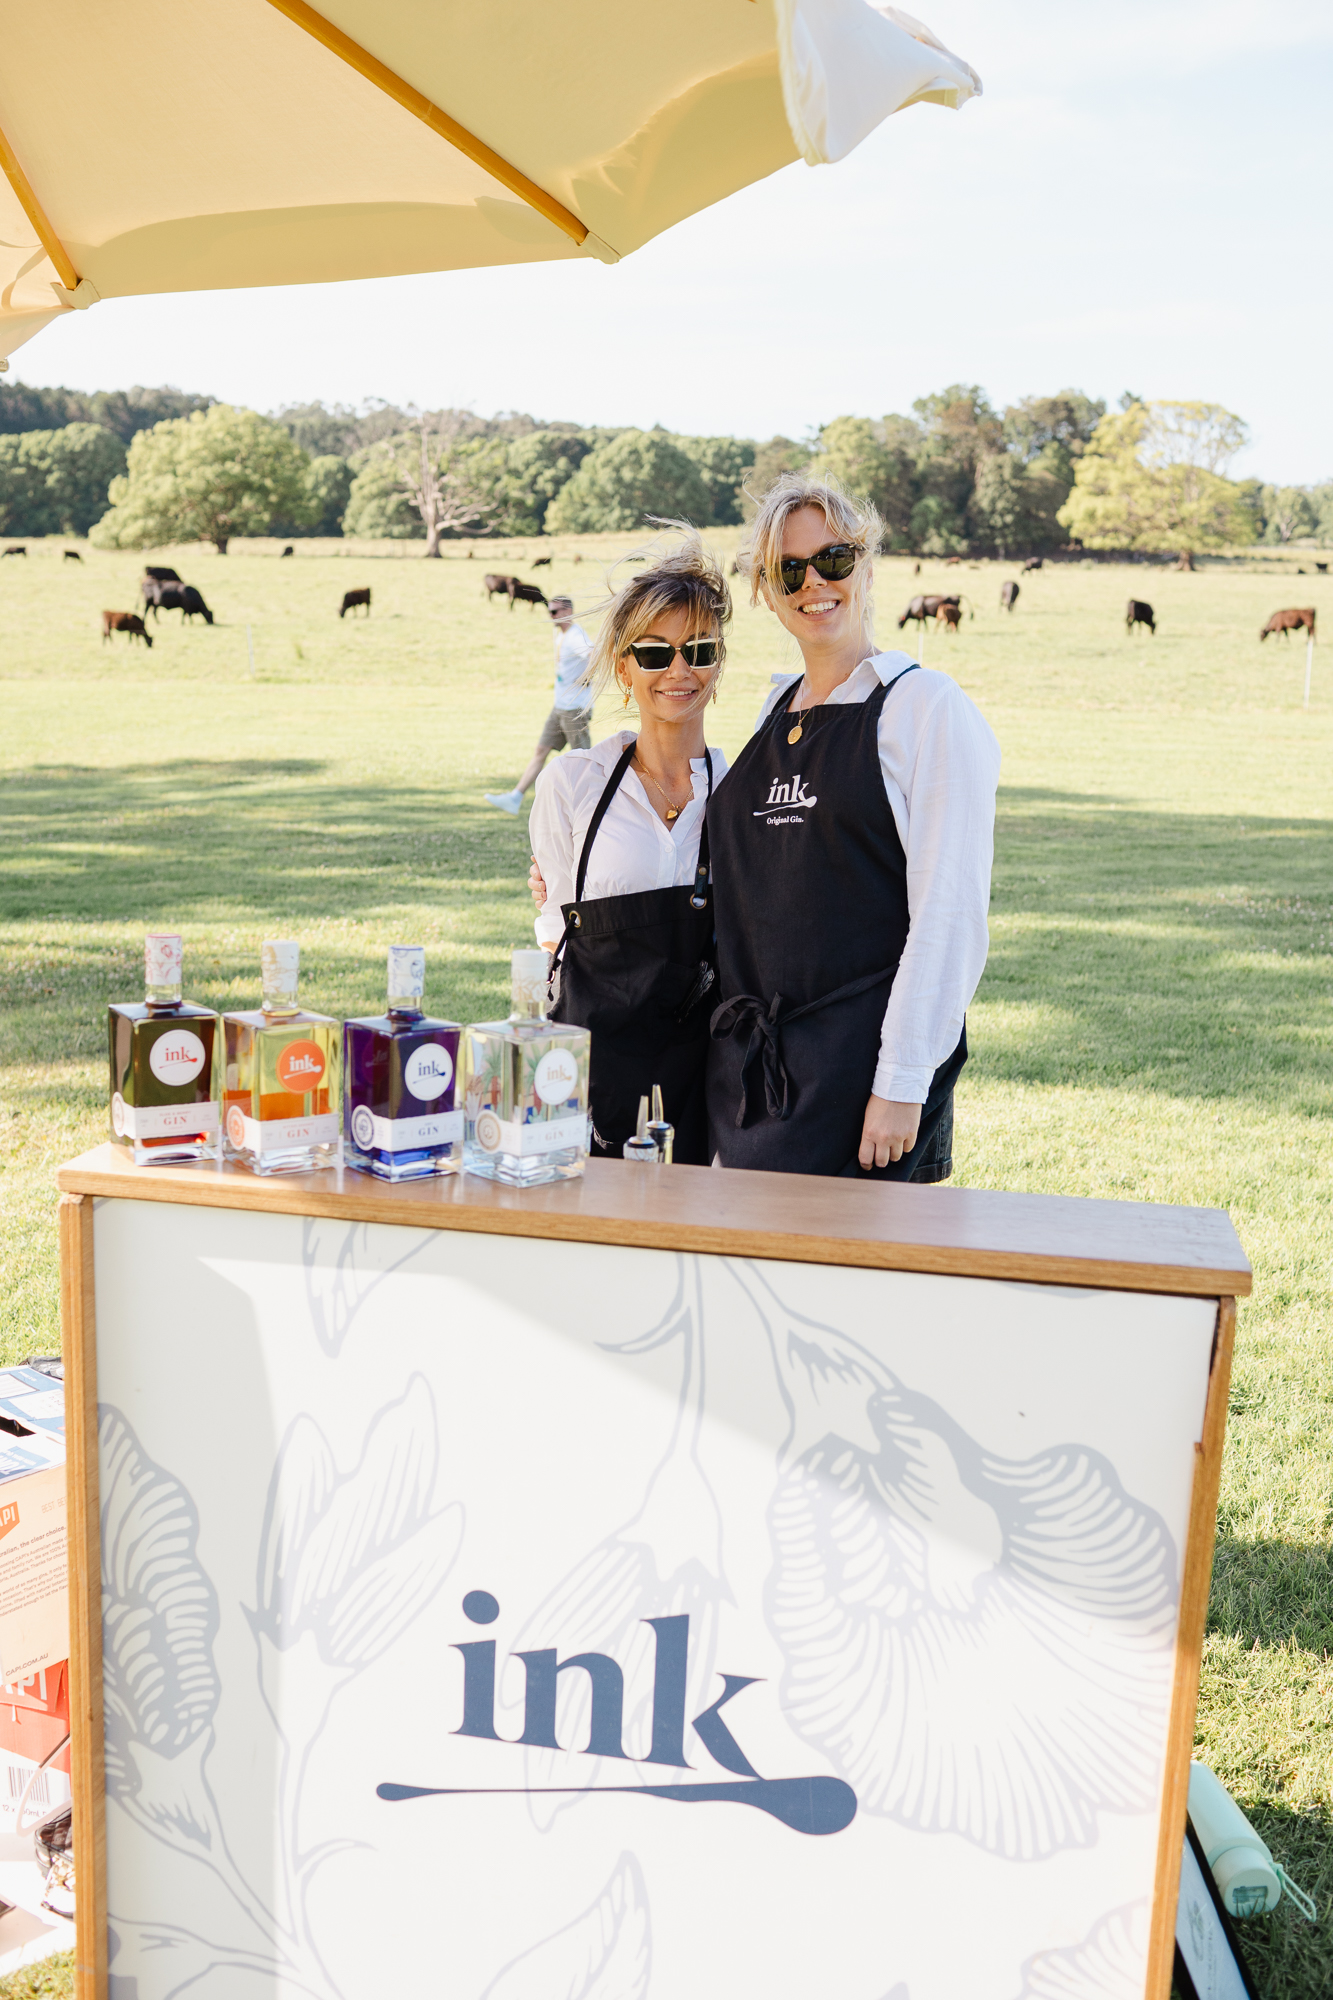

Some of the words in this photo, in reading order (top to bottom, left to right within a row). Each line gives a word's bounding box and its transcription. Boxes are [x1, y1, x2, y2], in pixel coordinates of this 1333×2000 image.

[765, 774, 810, 804] ink
[766, 815, 789, 826] Original
[165, 1046, 190, 1062] ink
[289, 1054, 315, 1072] ink
[418, 1060, 440, 1077] ink
[546, 1064, 567, 1081] ink
[163, 1115, 188, 1126] GIN
[287, 1128, 310, 1138] GIN
[418, 1125, 439, 1136] GIN
[544, 1130, 564, 1142] GIN
[20, 1541, 30, 1549] the
[31, 1534, 45, 1544] clear
[448, 1590, 768, 1781] ink
